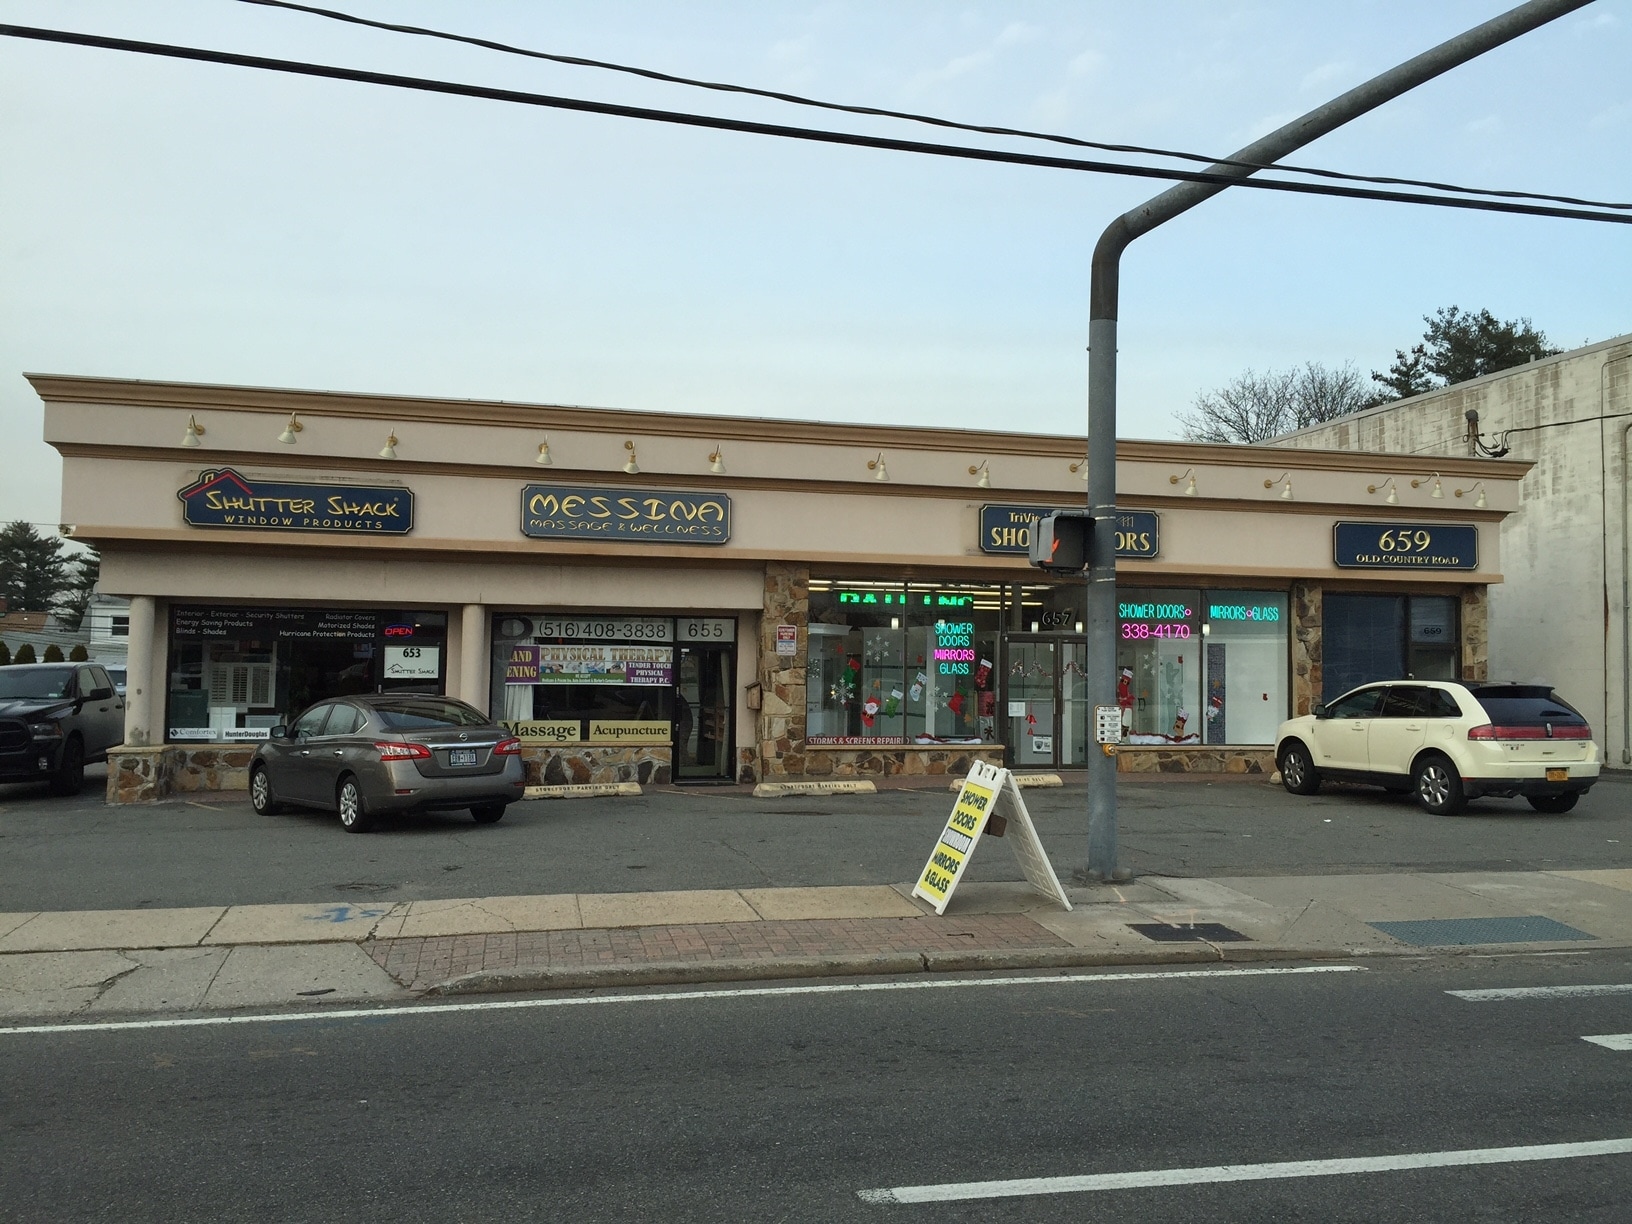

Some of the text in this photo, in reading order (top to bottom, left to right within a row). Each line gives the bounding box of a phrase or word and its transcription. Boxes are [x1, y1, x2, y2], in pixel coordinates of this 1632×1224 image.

[206, 491, 399, 517] SHUTTER SHACK
[529, 493, 724, 522] MESSINA
[224, 515, 383, 529] WINDOW PRODUCTS
[530, 519, 723, 536] MASSAGE & WELLNESS
[991, 527, 1030, 547] SHO
[1378, 529, 1431, 552] 659
[1356, 554, 1459, 565] OLD COUNTRY ROAD
[245, 611, 273, 620] Security
[275, 612, 305, 620] Shutters
[1119, 603, 1185, 619] SHOWER DOORS
[1210, 605, 1279, 621] MIRRORS GLASS
[176, 618, 200, 626] Energy
[201, 619, 223, 627] Saving
[1041, 611, 1073, 626] 657
[312, 630, 346, 638] Protection
[384, 627, 413, 636] OPEN
[539, 621, 666, 639] (516)408-3838
[688, 623, 723, 638] 655
[934, 623, 974, 634] SHOWER
[1121, 624, 1191, 639] 338-4170
[1423, 627, 1442, 635] 659
[938, 635, 970, 647] DOORS
[403, 648, 421, 658] 653
[540, 647, 673, 663] PHYSICAL THERAPY
[934, 649, 975, 661] MIRRORS
[939, 663, 970, 675] GLASS
[179, 728, 217, 736] Comfortex
[225, 730, 268, 738] HunterDouglas
[502, 722, 577, 741] Massage
[593, 725, 668, 739] Acupuncture
[808, 737, 838, 745] STORMS
[838, 737, 844, 745] &
[845, 737, 876, 745] SCREENS
[960, 790, 988, 811] SHOWER
[952, 810, 977, 831] DOORS
[931, 851, 960, 875] MIRRORS
